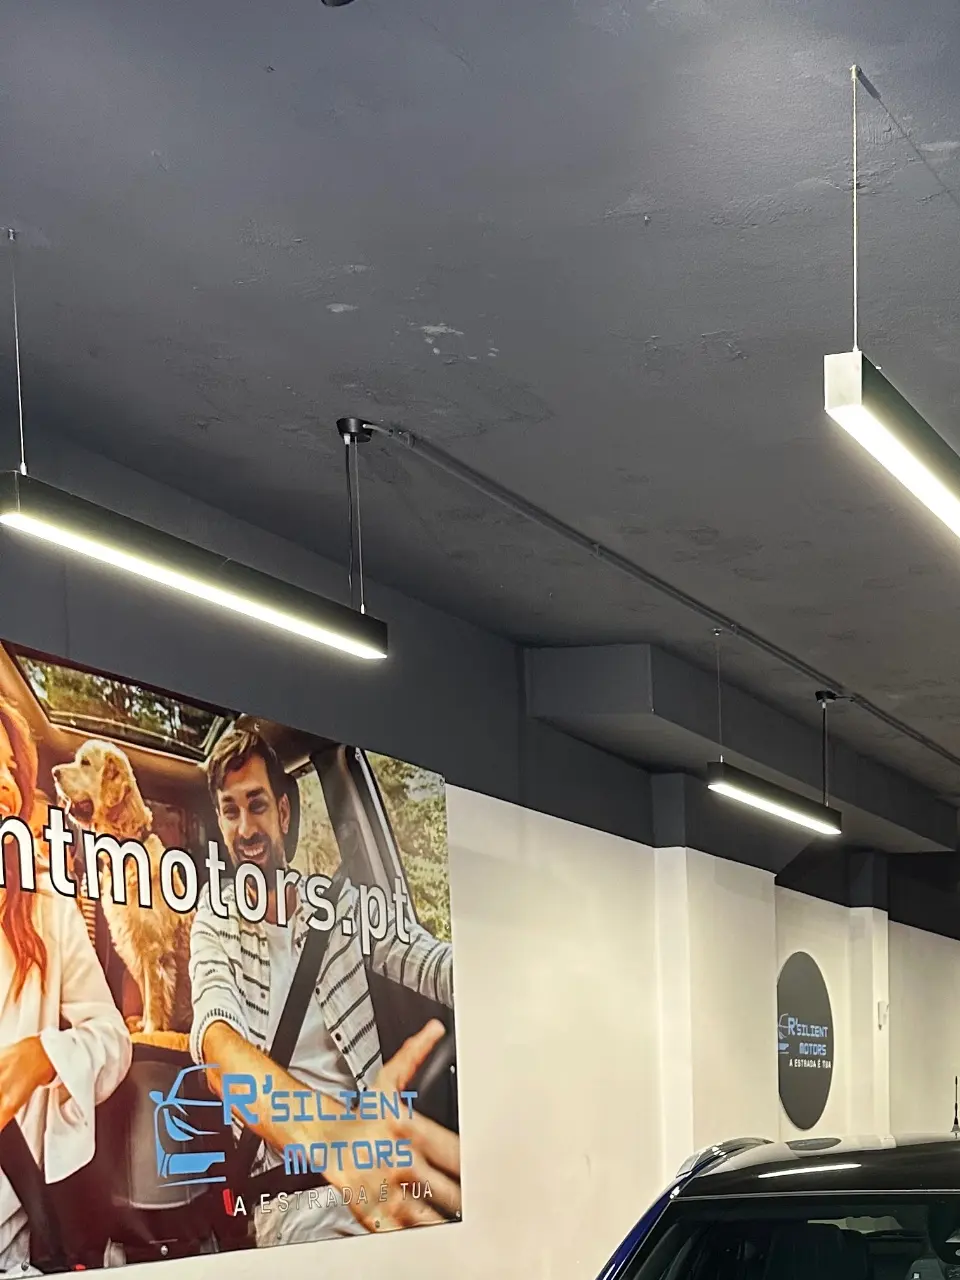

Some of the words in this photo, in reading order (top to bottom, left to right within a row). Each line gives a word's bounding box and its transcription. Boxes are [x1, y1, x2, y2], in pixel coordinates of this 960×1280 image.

[284, 1139, 413, 1175] MOTORS
[233, 1196, 247, 1217] A
[260, 1185, 368, 1214] ESTRADA
[379, 1178, 388, 1203] É
[400, 1181, 433, 1200] TUA
